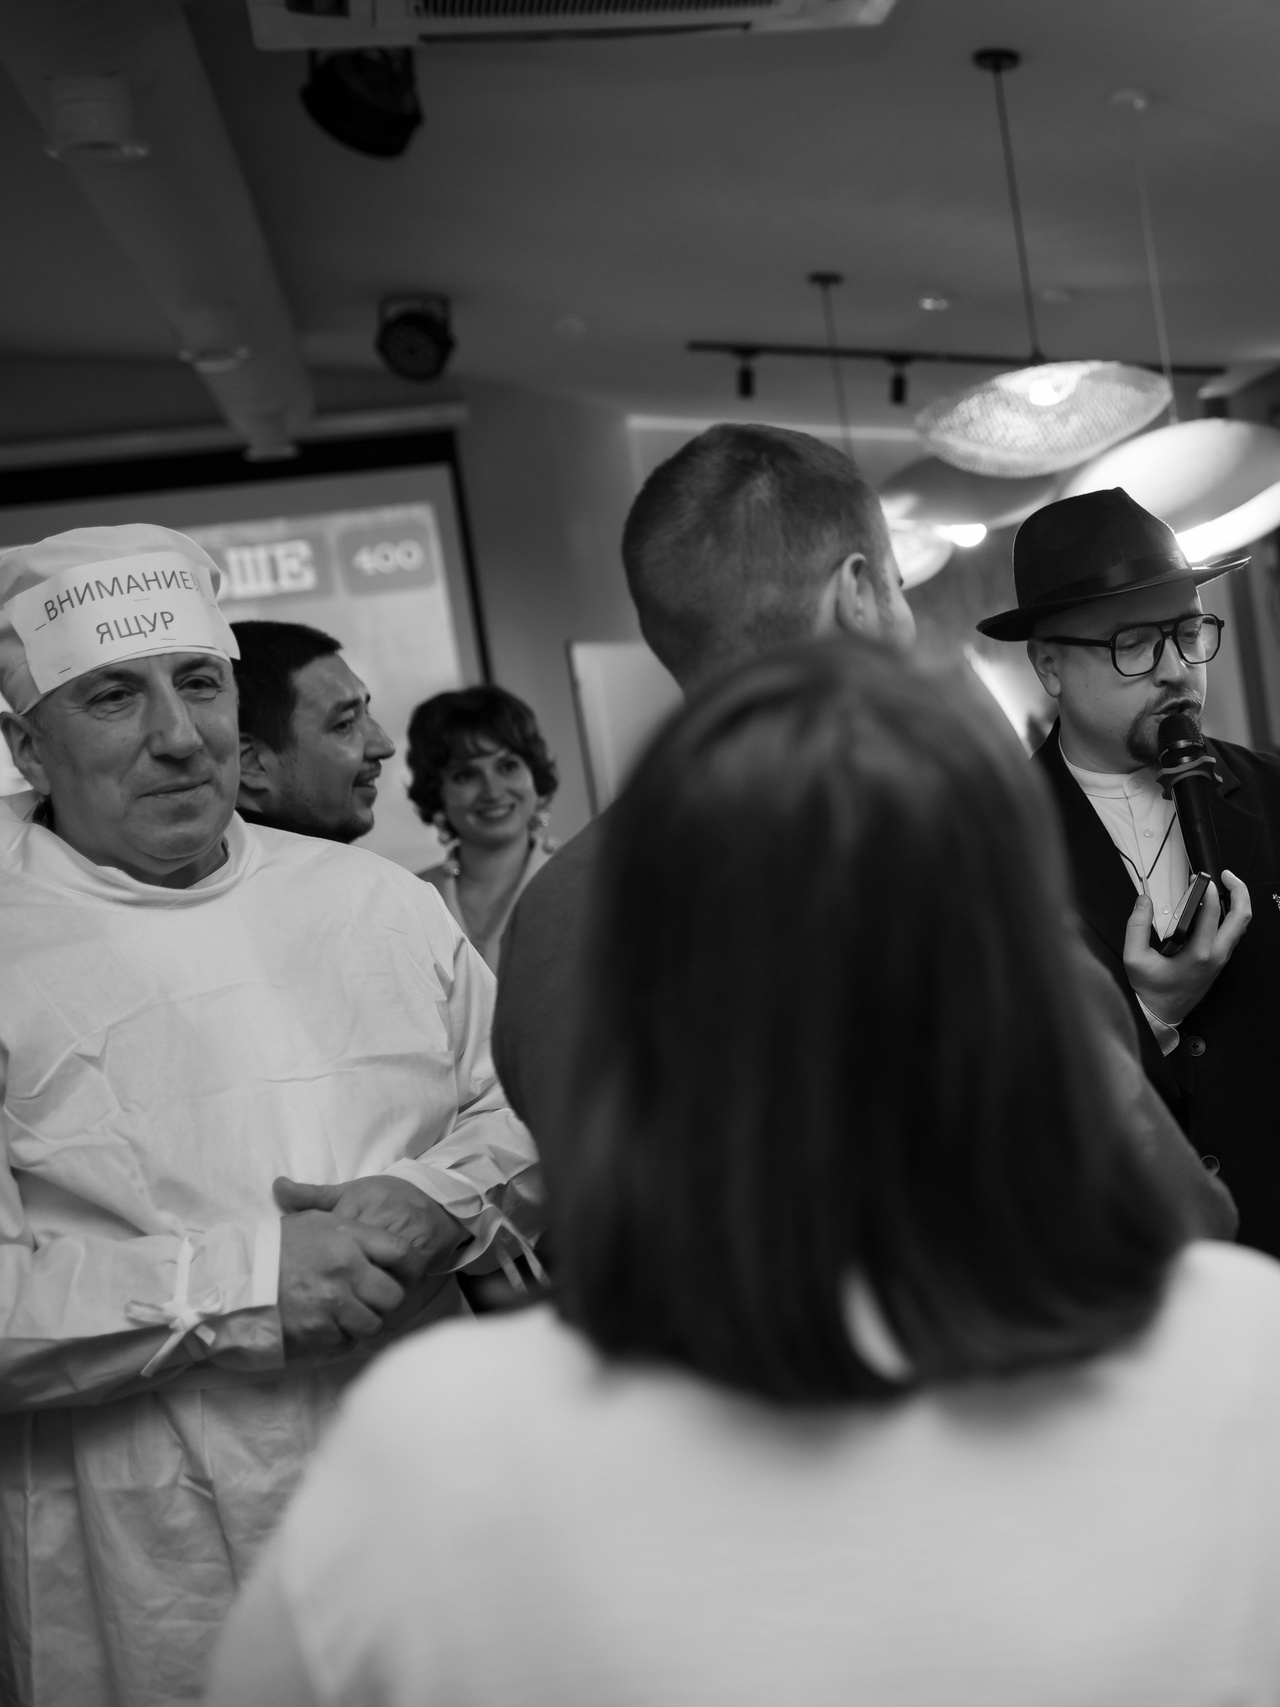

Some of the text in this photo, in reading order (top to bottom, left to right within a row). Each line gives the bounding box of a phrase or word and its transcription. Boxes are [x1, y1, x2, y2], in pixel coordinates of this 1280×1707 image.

[215, 539, 318, 601] ШЕ
[352, 539, 425, 577] 400
[96, 611, 175, 645] ЯЩУР
